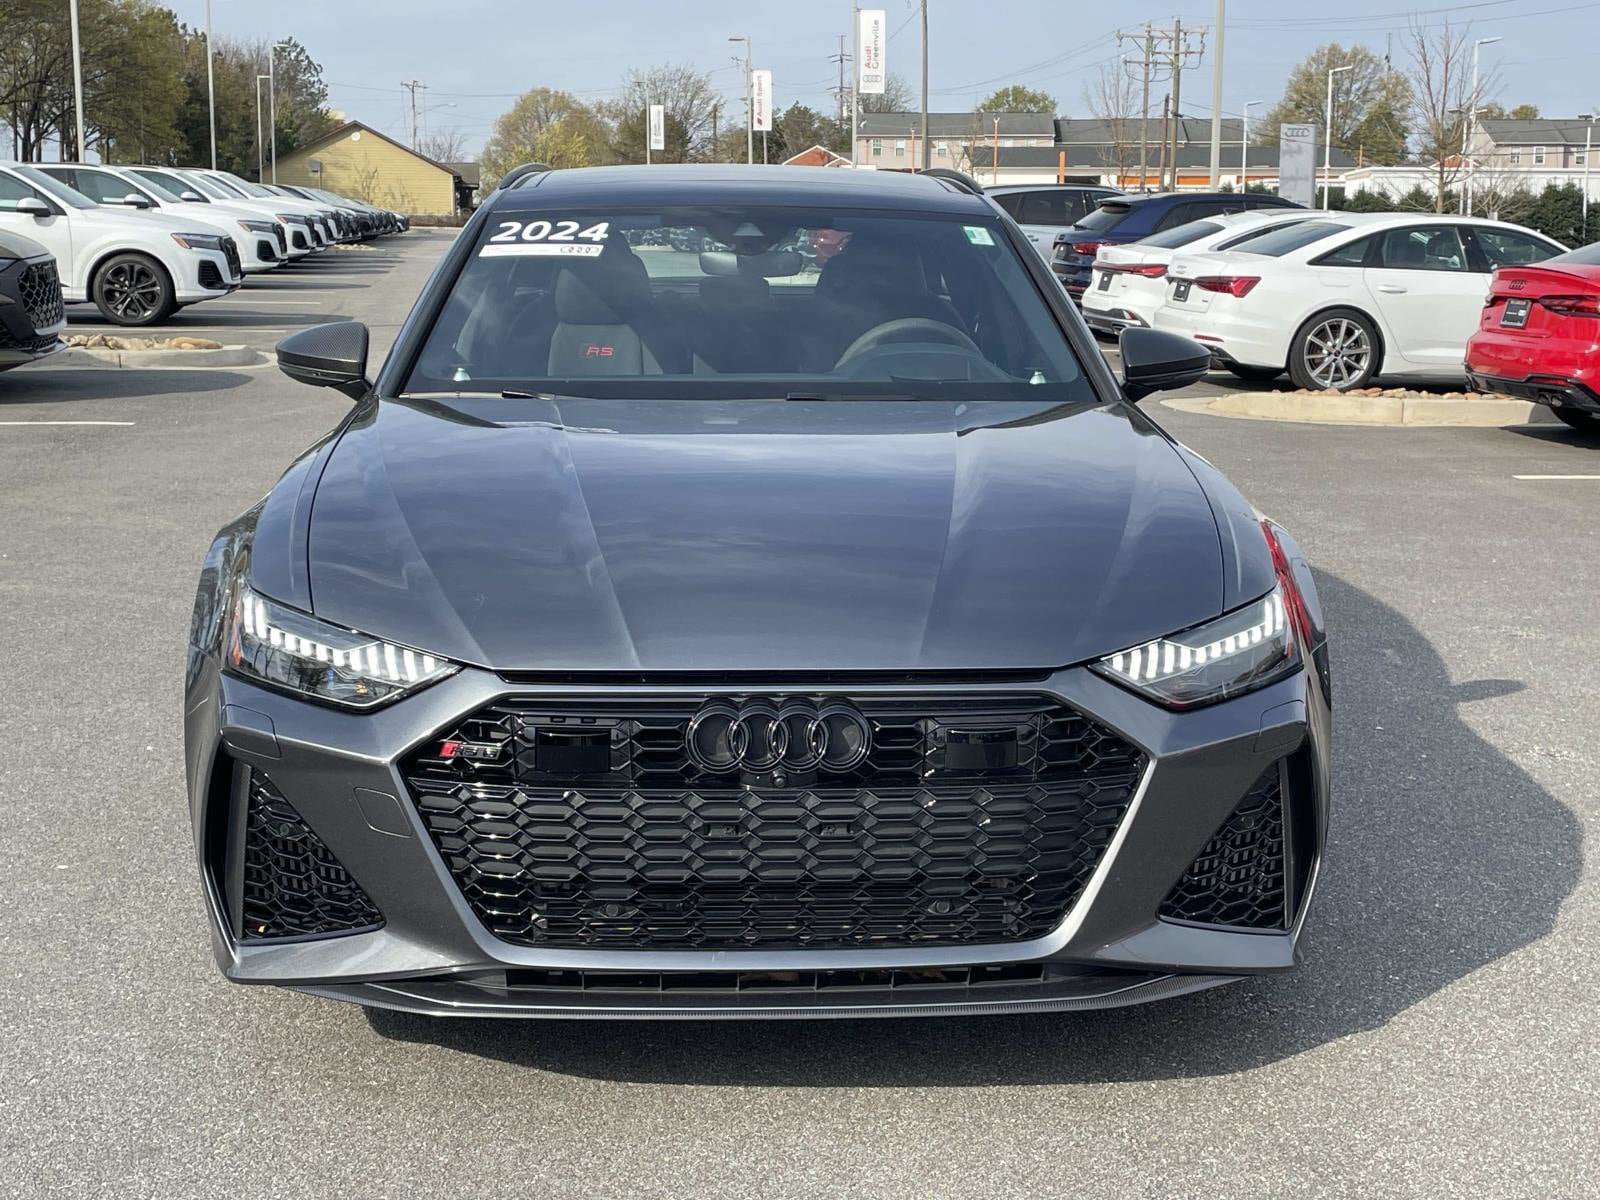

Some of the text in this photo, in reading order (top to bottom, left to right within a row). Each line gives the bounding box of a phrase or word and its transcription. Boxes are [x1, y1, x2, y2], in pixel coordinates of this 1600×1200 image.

[872, 19, 880, 70] Greenville
[864, 46, 872, 69] Audi
[490, 221, 610, 242] 2024
